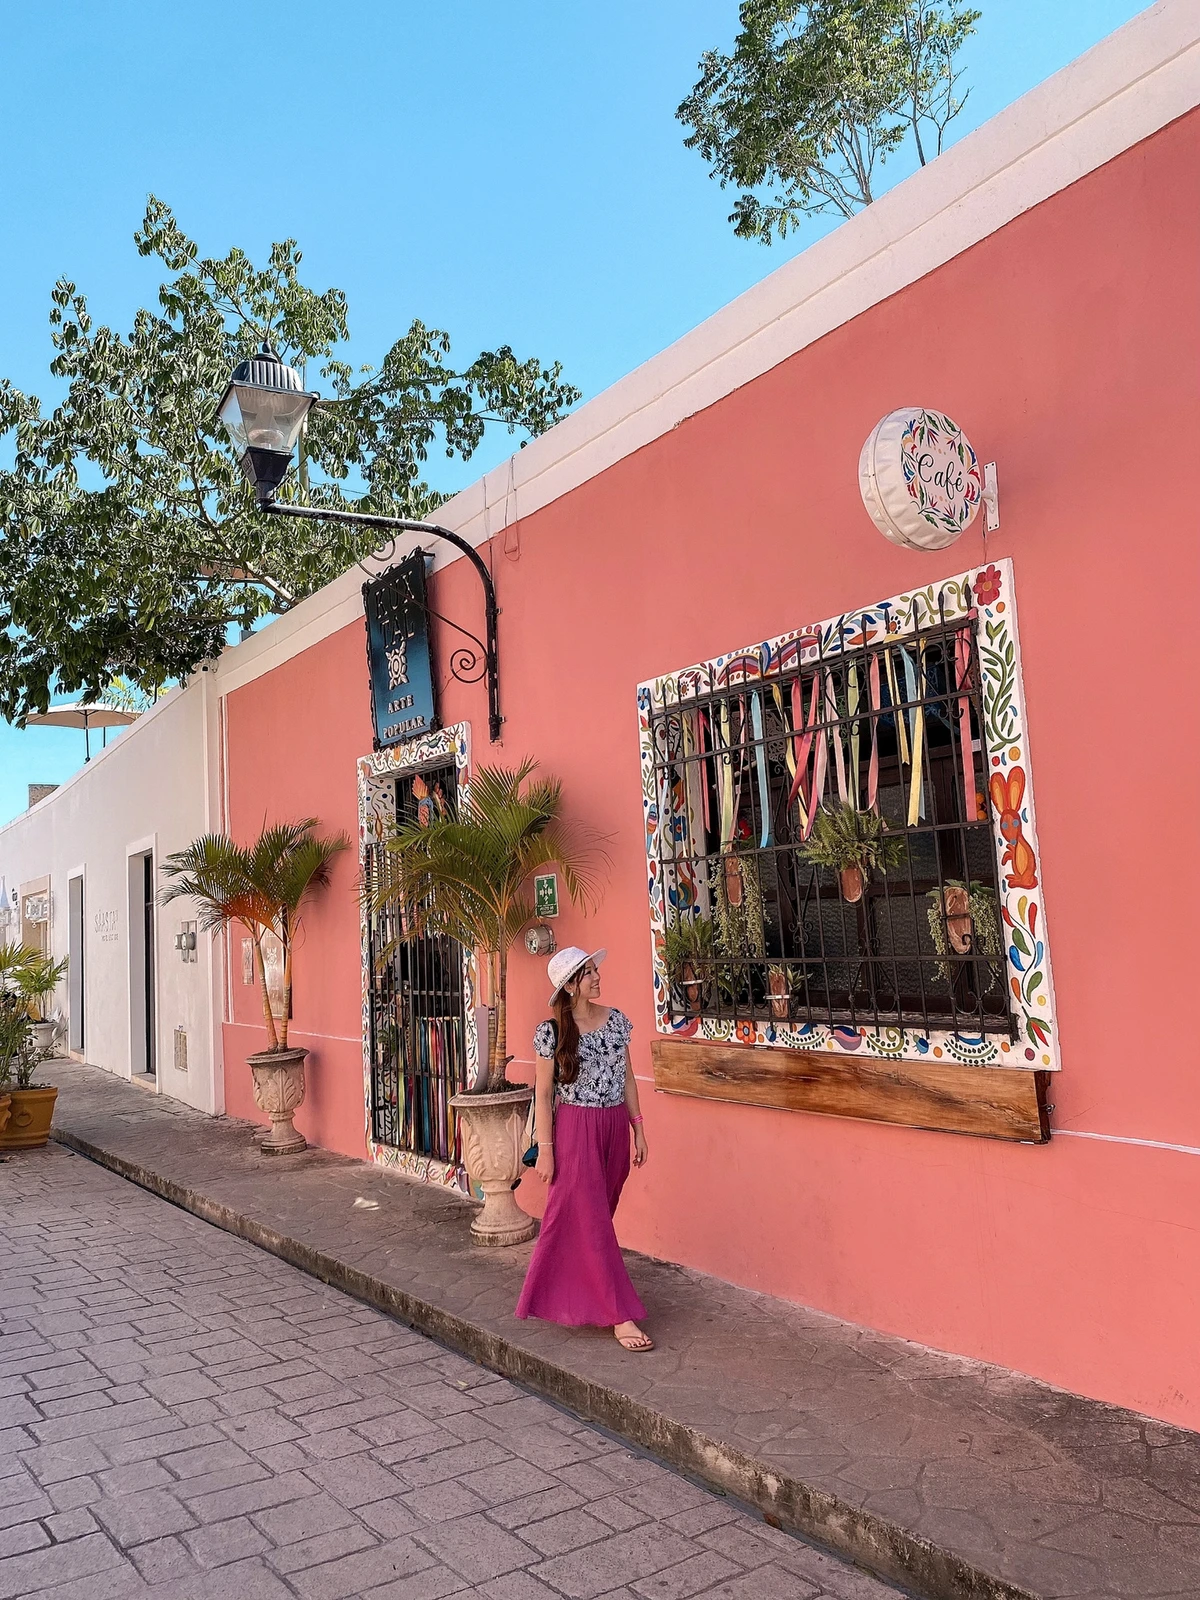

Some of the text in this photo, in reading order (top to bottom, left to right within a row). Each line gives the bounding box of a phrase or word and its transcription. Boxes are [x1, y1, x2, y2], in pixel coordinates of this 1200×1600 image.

[916, 453, 965, 500] Café
[375, 571, 415, 619] KUX
[380, 609, 415, 649] TAL
[387, 694, 415, 715] ARTE
[383, 716, 425, 739] POPULAR
